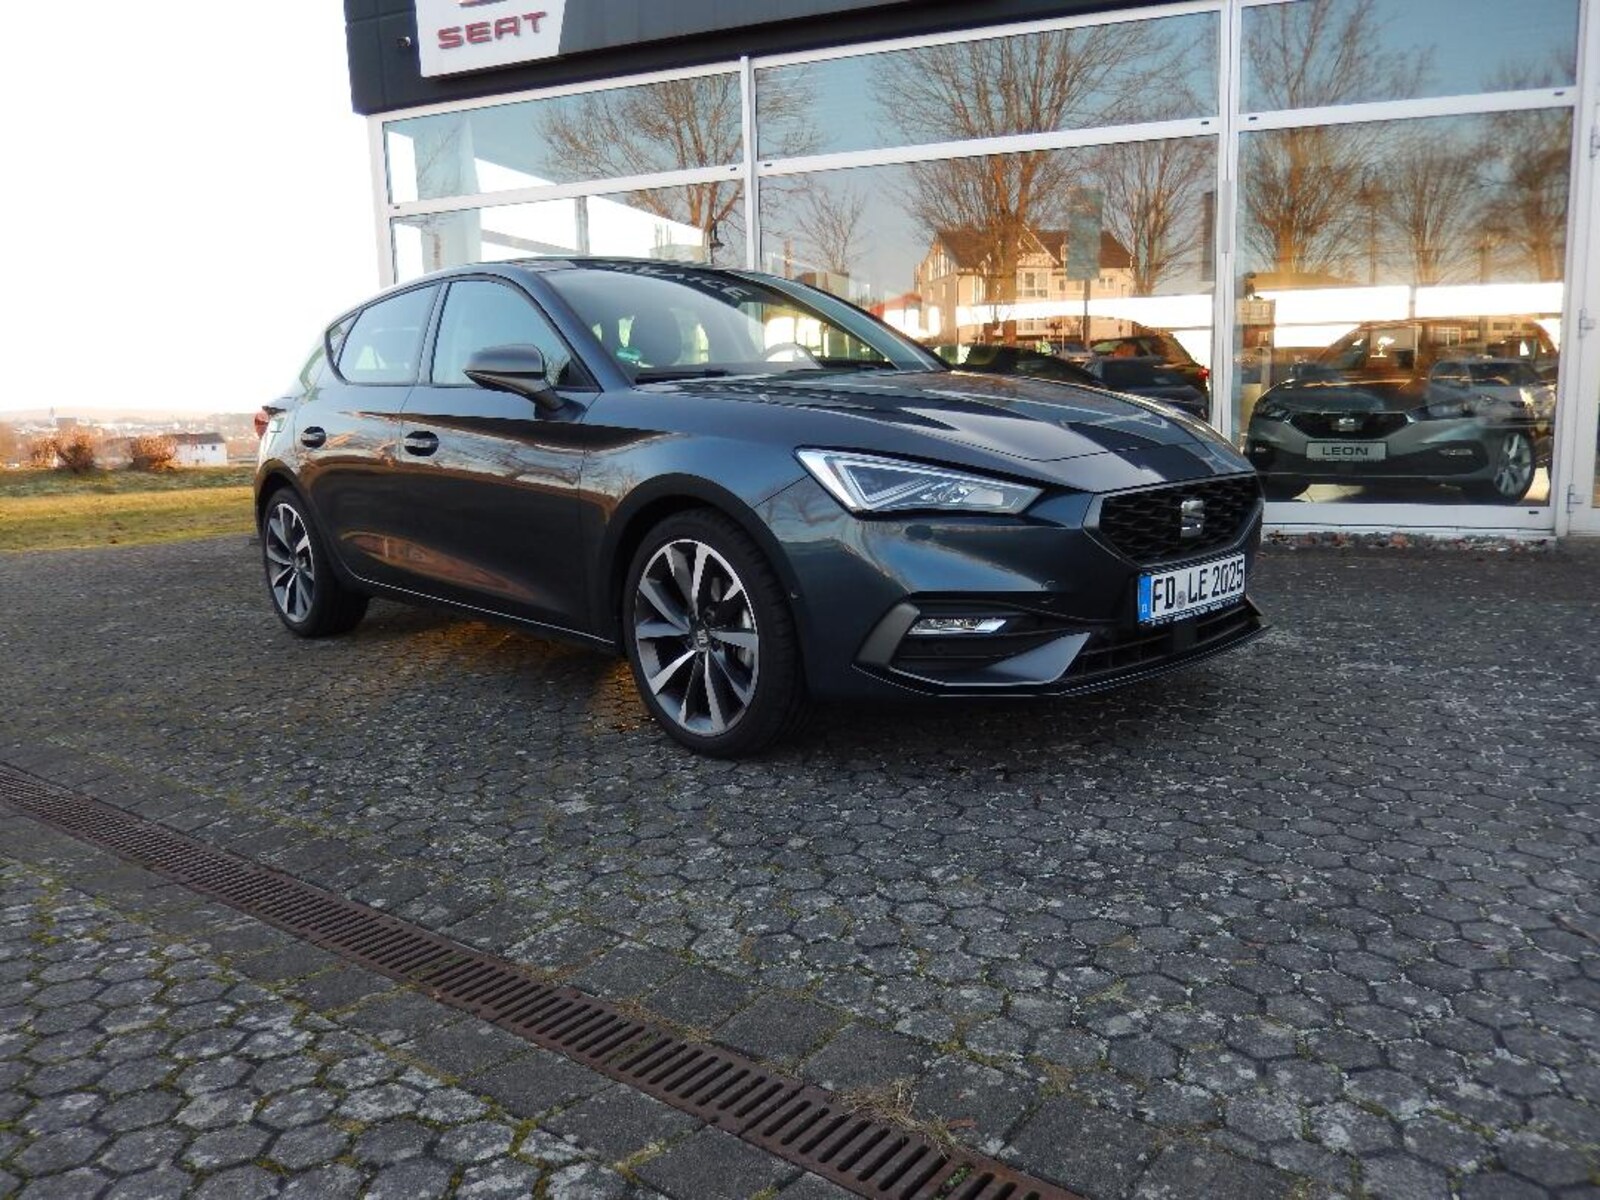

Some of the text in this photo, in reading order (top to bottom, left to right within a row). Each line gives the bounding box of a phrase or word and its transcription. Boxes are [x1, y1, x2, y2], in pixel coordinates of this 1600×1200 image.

[437, 11, 547, 49] SEAT
[1322, 446, 1368, 456] LEON
[1153, 577, 1175, 612] FD
[1188, 568, 1208, 603] LE
[1211, 558, 1243, 597] 2025
